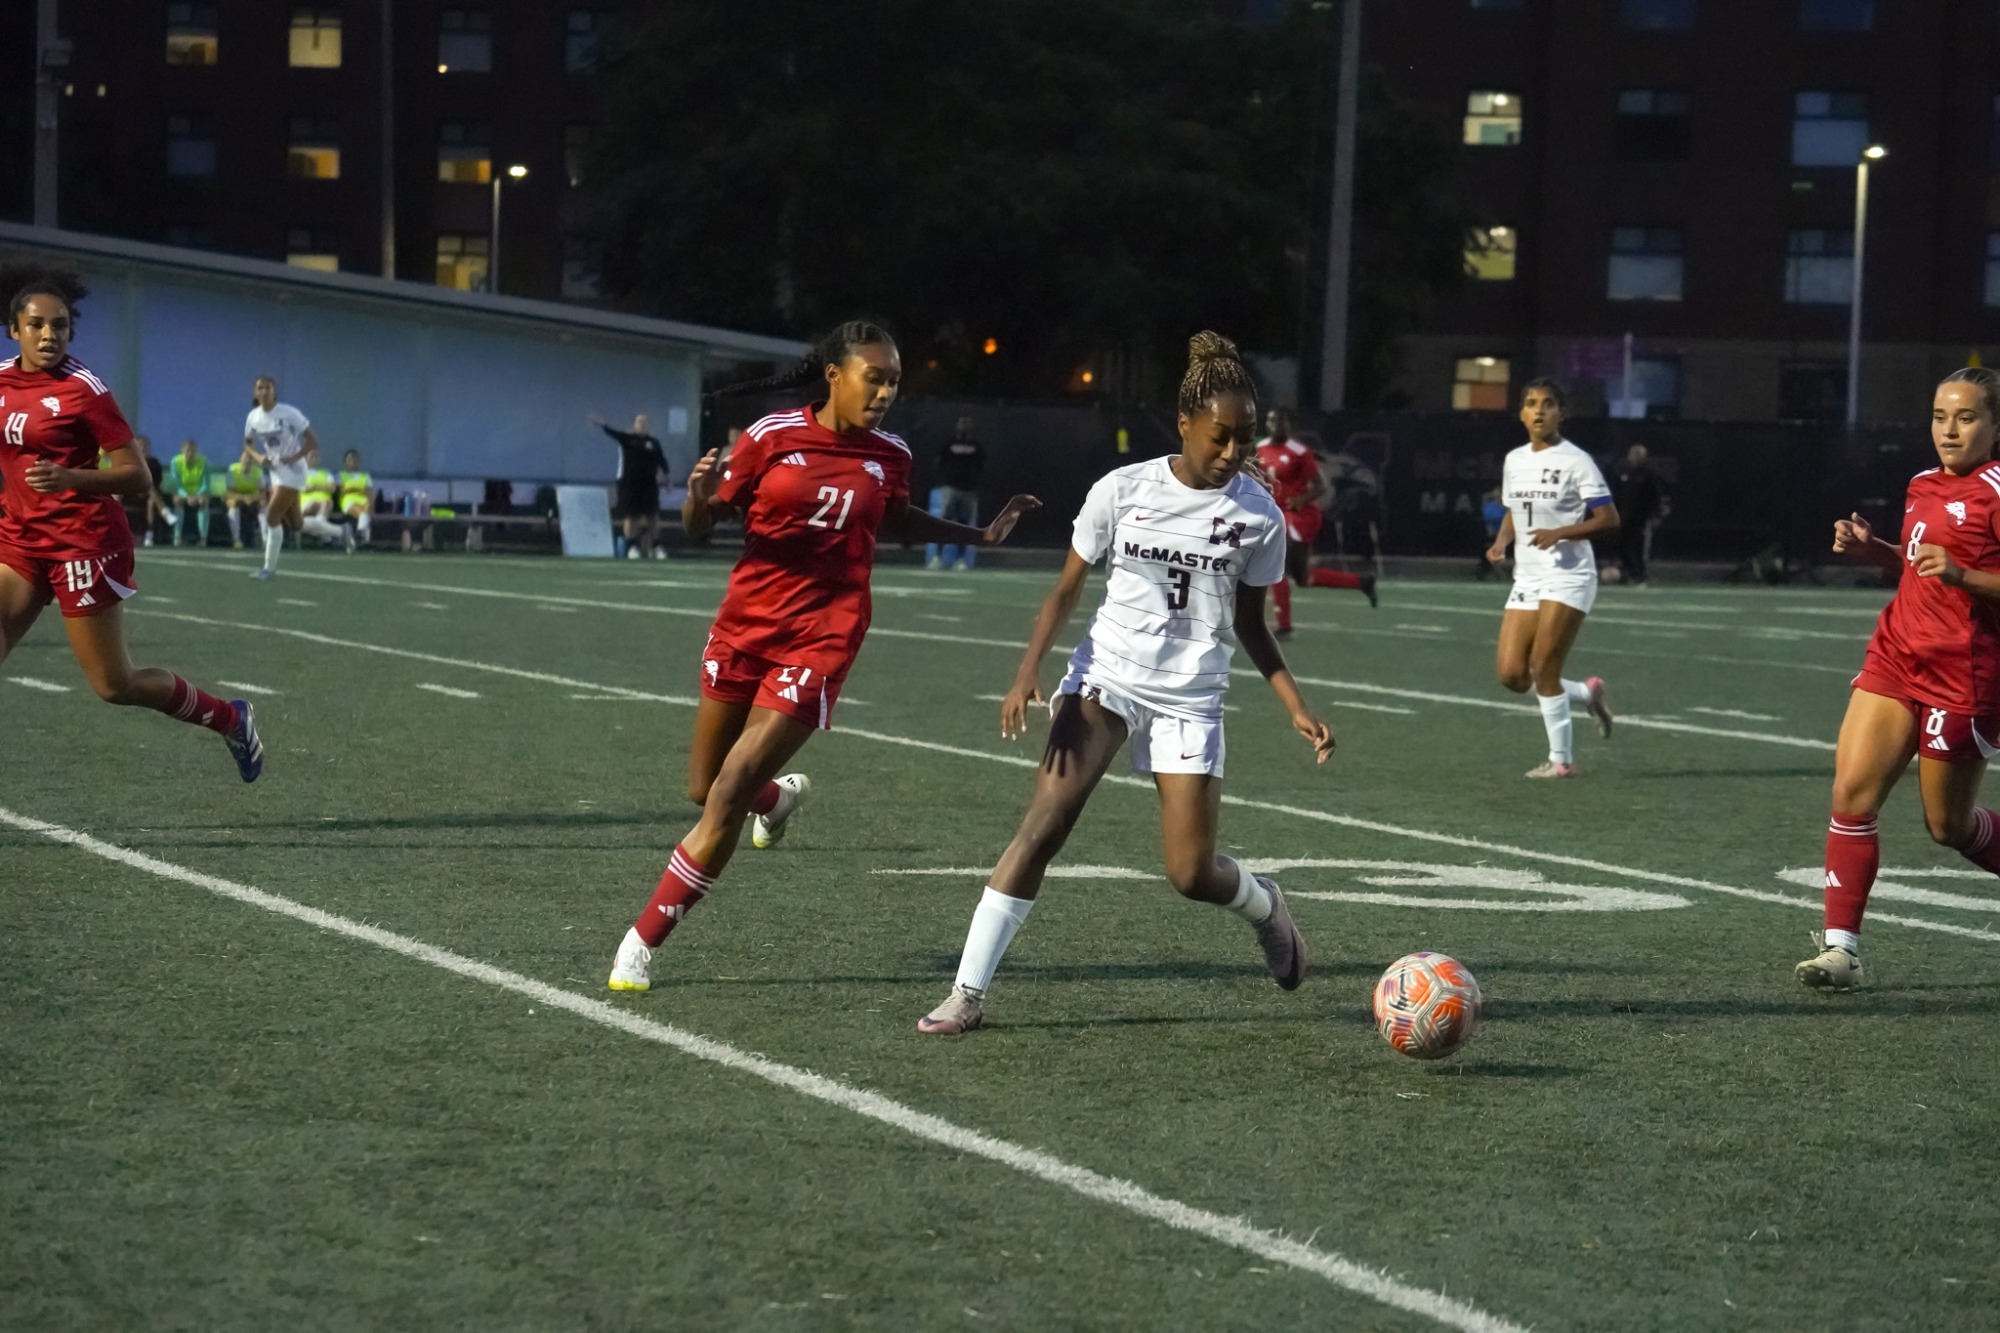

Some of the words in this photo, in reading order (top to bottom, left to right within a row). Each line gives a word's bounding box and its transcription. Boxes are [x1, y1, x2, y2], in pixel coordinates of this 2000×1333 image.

[4, 412, 29, 446] 19
[807, 485, 855, 530] 21
[1522, 501, 1533, 528] 7
[1124, 541, 1231, 572] McMASTER
[1906, 520, 1927, 562] 8
[65, 559, 94, 592] 19
[1167, 567, 1191, 610] 3
